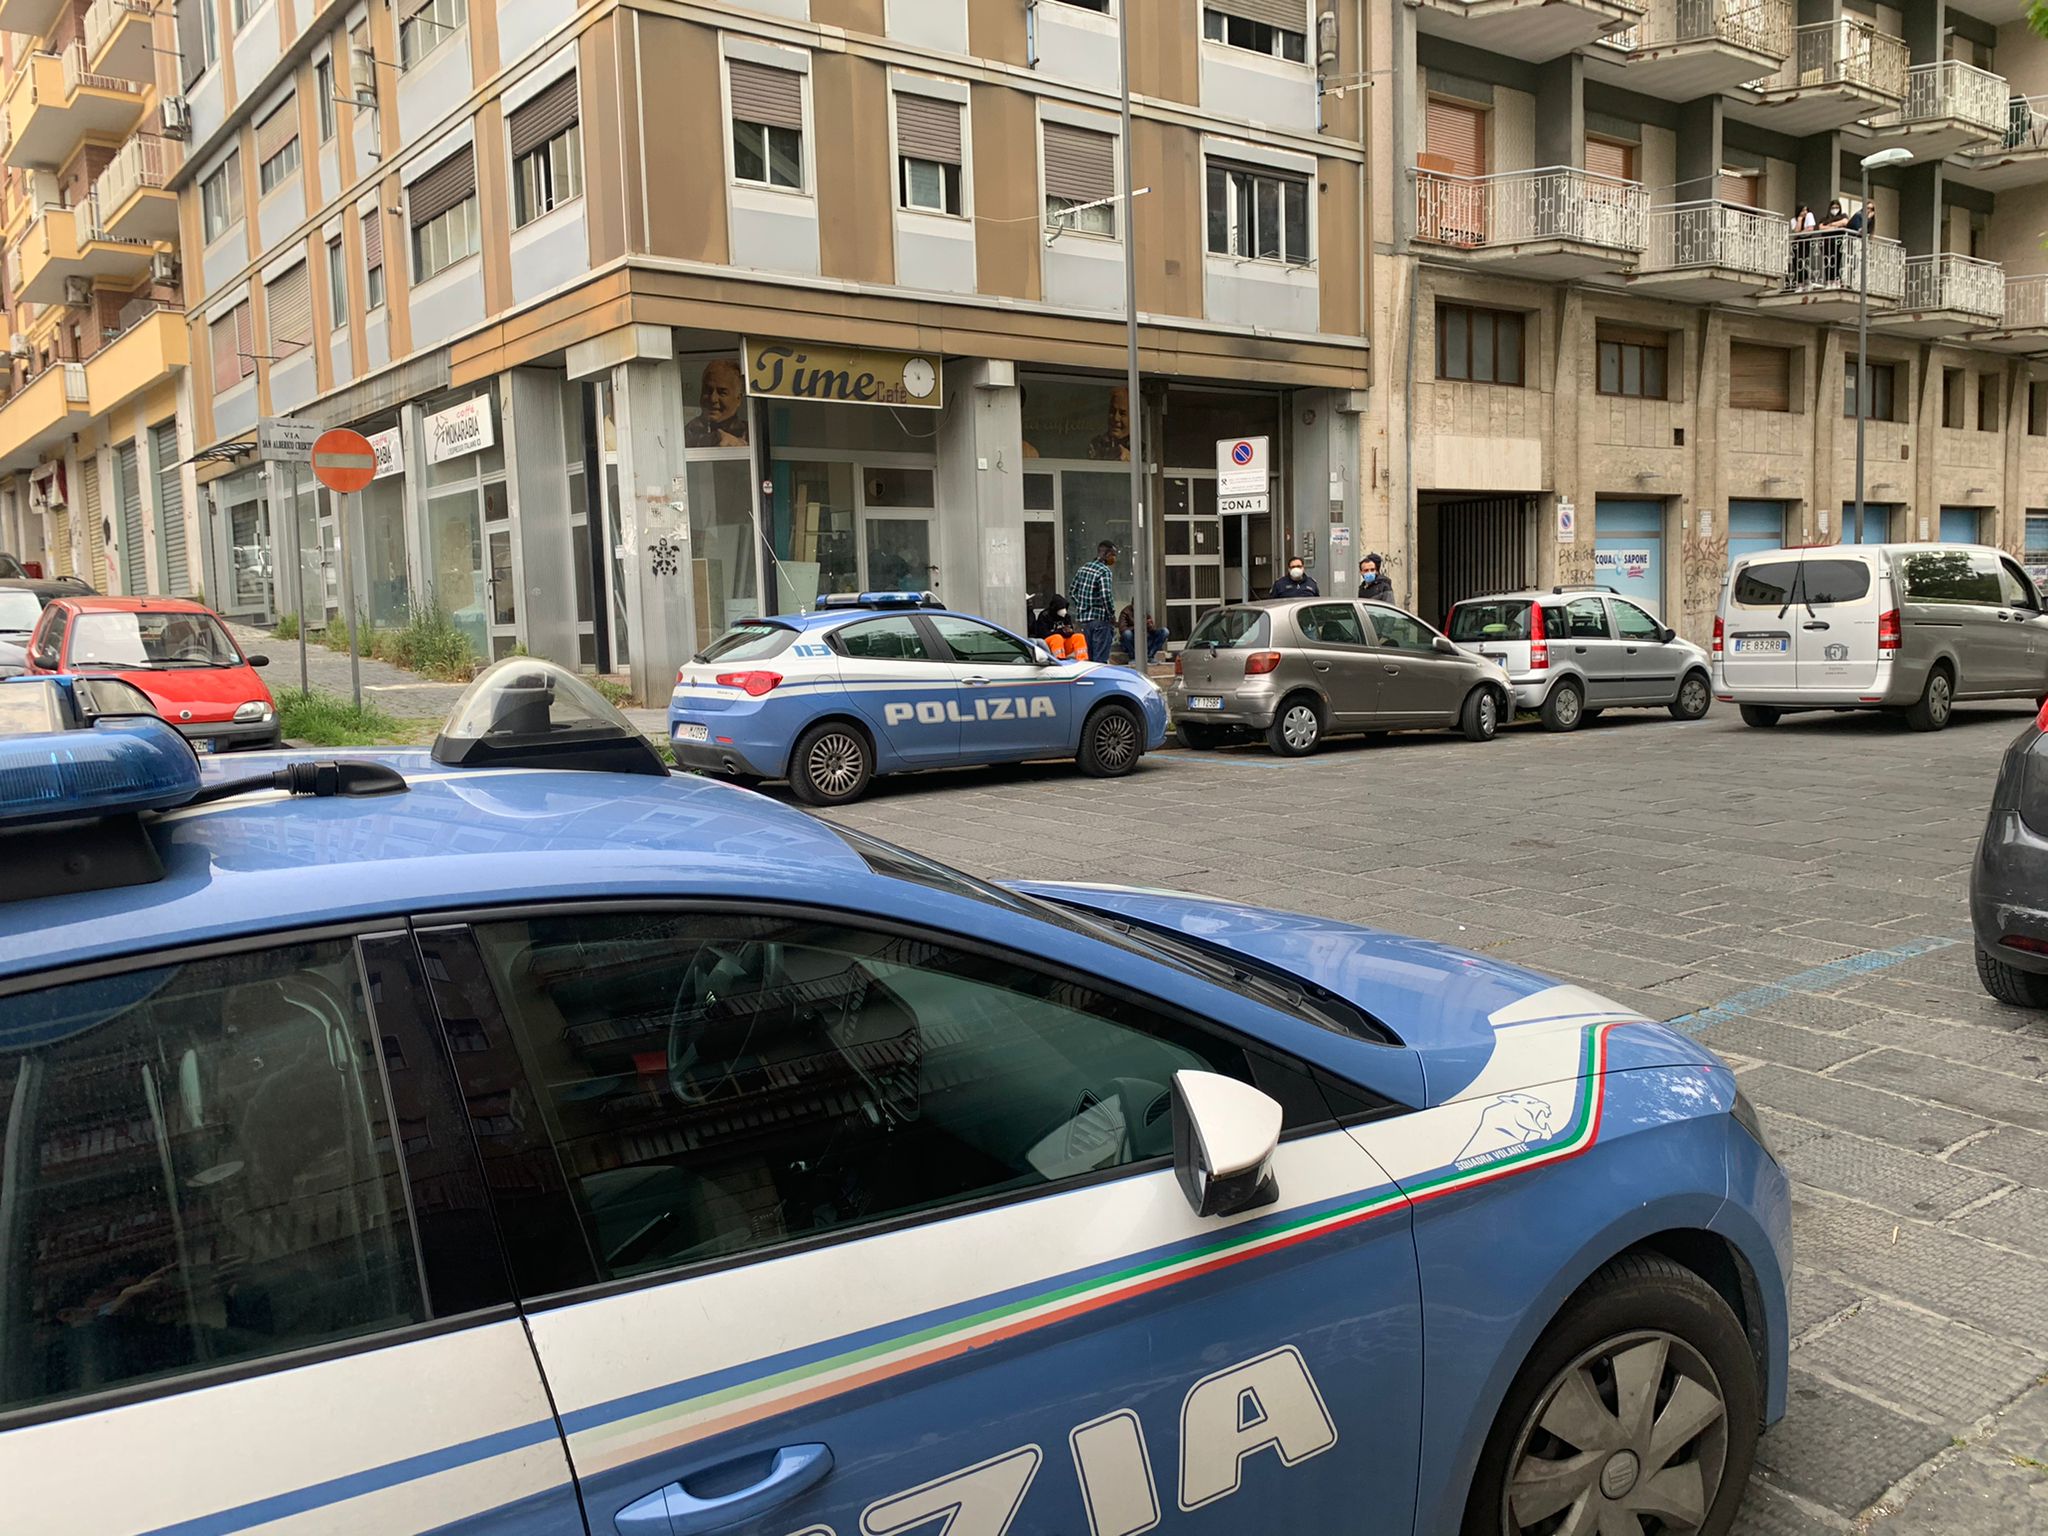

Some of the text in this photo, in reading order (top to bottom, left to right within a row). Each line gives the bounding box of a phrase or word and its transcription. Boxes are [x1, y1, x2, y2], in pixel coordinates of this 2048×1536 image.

[750, 346, 877, 401] Time
[284, 432, 300, 440] VIA
[445, 416, 480, 446] MOKARABIA
[262, 440, 272, 448] SAN
[1222, 499, 1261, 511] ZONA 1
[1595, 554, 1612, 566] CQUA
[1624, 554, 1648, 564] SAPONE
[792, 644, 832, 657] 113
[1741, 640, 1751, 650] FE
[884, 696, 1057, 727] POLIZIA
[1454, 1143, 1530, 1171] SQUADRA VOLANTE
